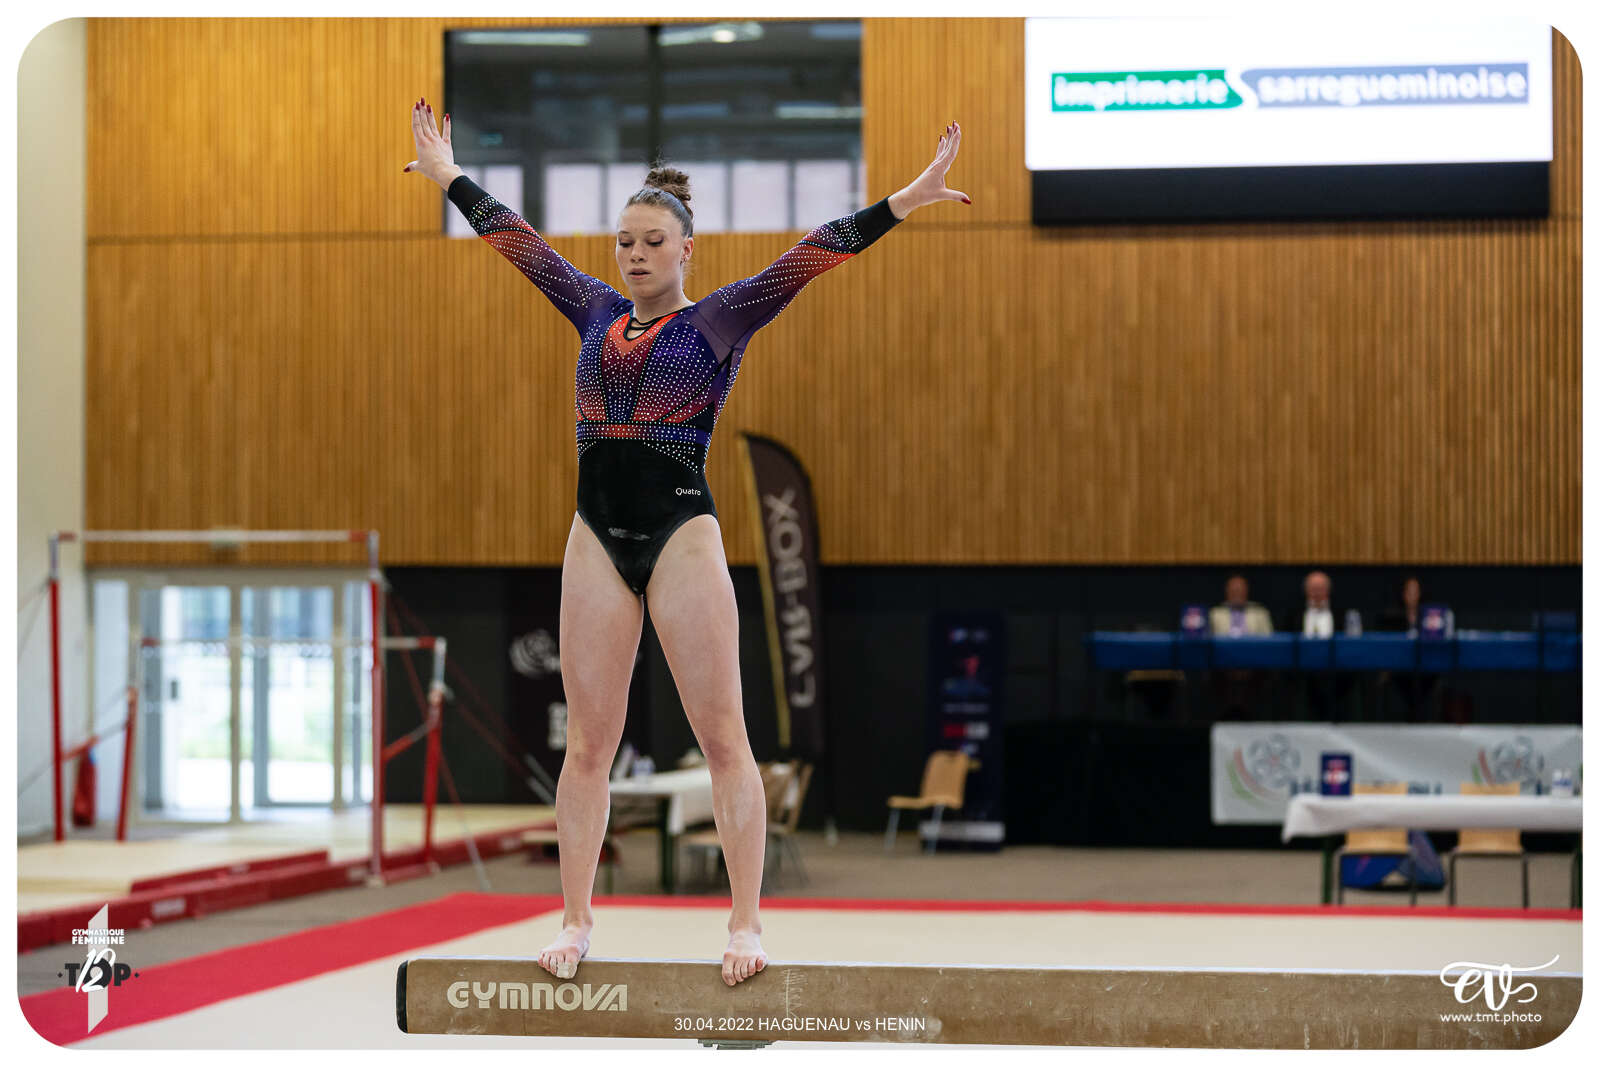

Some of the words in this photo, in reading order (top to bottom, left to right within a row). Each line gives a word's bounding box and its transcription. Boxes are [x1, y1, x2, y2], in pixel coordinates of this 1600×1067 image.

[1053, 73, 1230, 111] imprimerie
[1258, 67, 1527, 106] sarregueminoise
[675, 487, 701, 496] Quatro
[447, 981, 628, 1012] GYMNOVA
